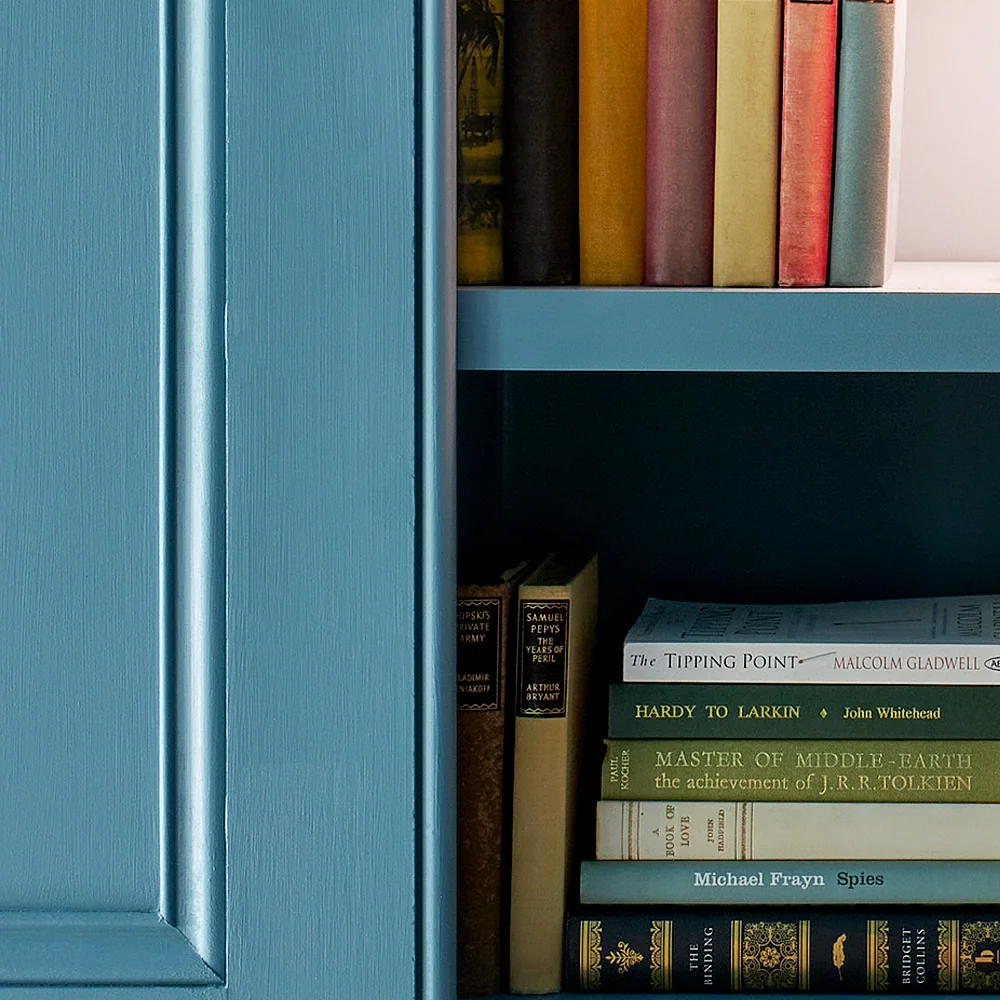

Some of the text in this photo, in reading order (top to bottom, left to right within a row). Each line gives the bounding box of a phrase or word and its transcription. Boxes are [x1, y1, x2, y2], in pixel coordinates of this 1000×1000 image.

[527, 613, 564, 621] SAMUEL
[631, 653, 979, 670] The TIPPING POINT MALCOLM GLADWELL
[527, 683, 560, 691] ARTHUR
[636, 705, 940, 719] HARDY TO LARKIN John Whitehead
[621, 749, 630, 790] KOCHER
[655, 752, 744, 767] MASTER
[755, 752, 783, 767] OF
[655, 773, 680, 789] the
[687, 774, 788, 789] achievement
[796, 774, 814, 790] of
[878, 776, 971, 791] TOLKIEN
[666, 805, 675, 856] BOOK OF
[681, 816, 689, 847] LOVE
[694, 872, 884, 889] Michael Frayn Spies
[690, 944, 699, 970] THE
[704, 927, 714, 985] BINDING
[902, 928, 911, 984] BRIDGET
[916, 929, 925, 984] COLLINS
